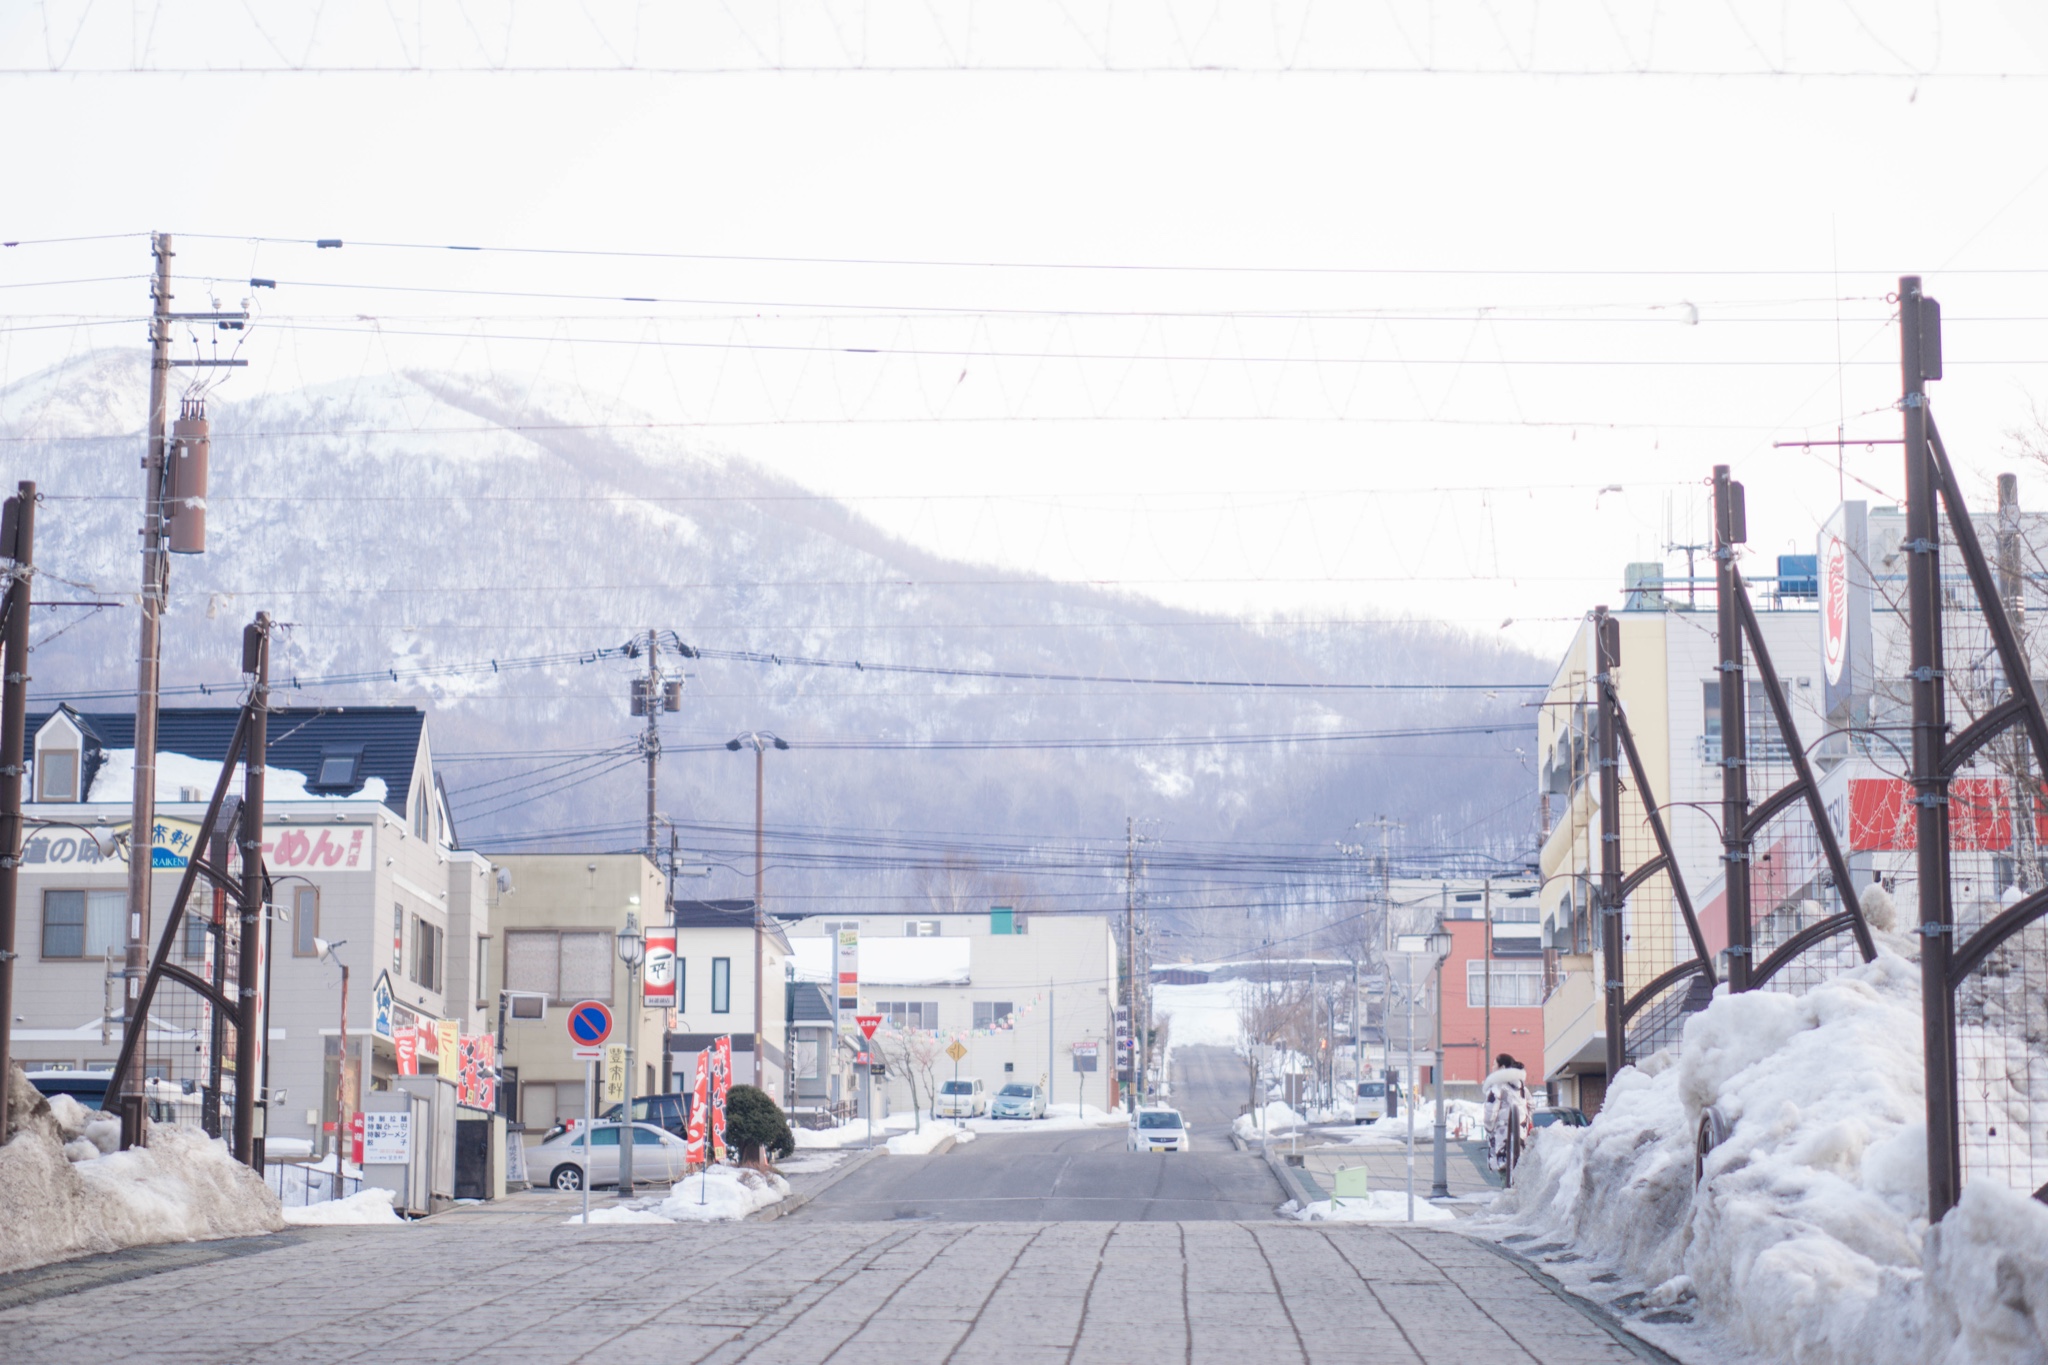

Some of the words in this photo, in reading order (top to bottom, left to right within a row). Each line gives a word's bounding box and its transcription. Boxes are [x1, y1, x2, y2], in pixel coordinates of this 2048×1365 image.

[152, 857, 186, 867] RAIKEN
[860, 1020, 878, 1028] 止まれ
